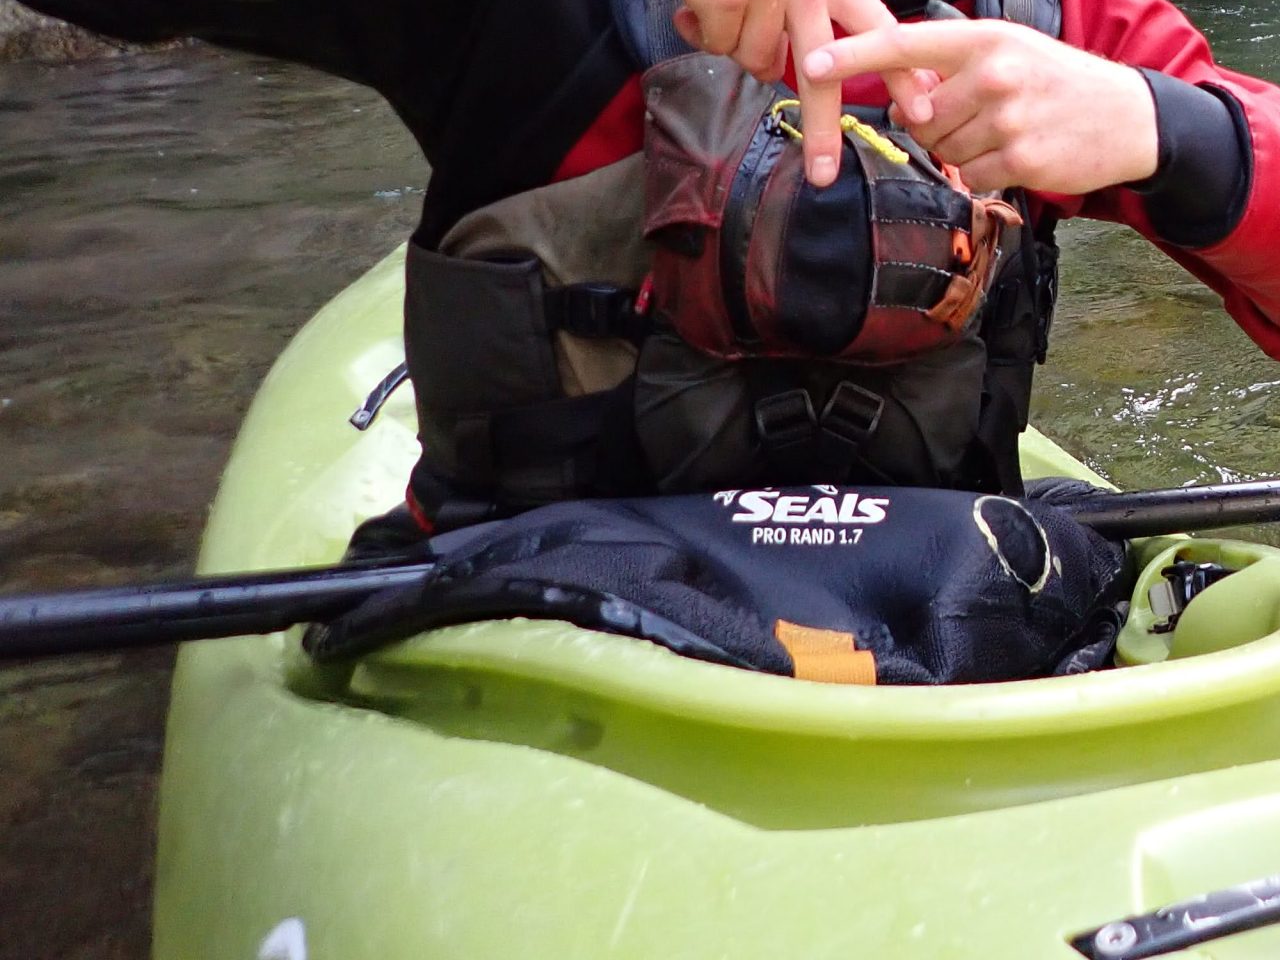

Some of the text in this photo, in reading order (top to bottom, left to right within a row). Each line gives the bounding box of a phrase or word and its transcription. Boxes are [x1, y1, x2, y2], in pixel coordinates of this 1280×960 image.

[732, 490, 890, 523] SEALS
[753, 527, 863, 545] PRO RAND 1.7
